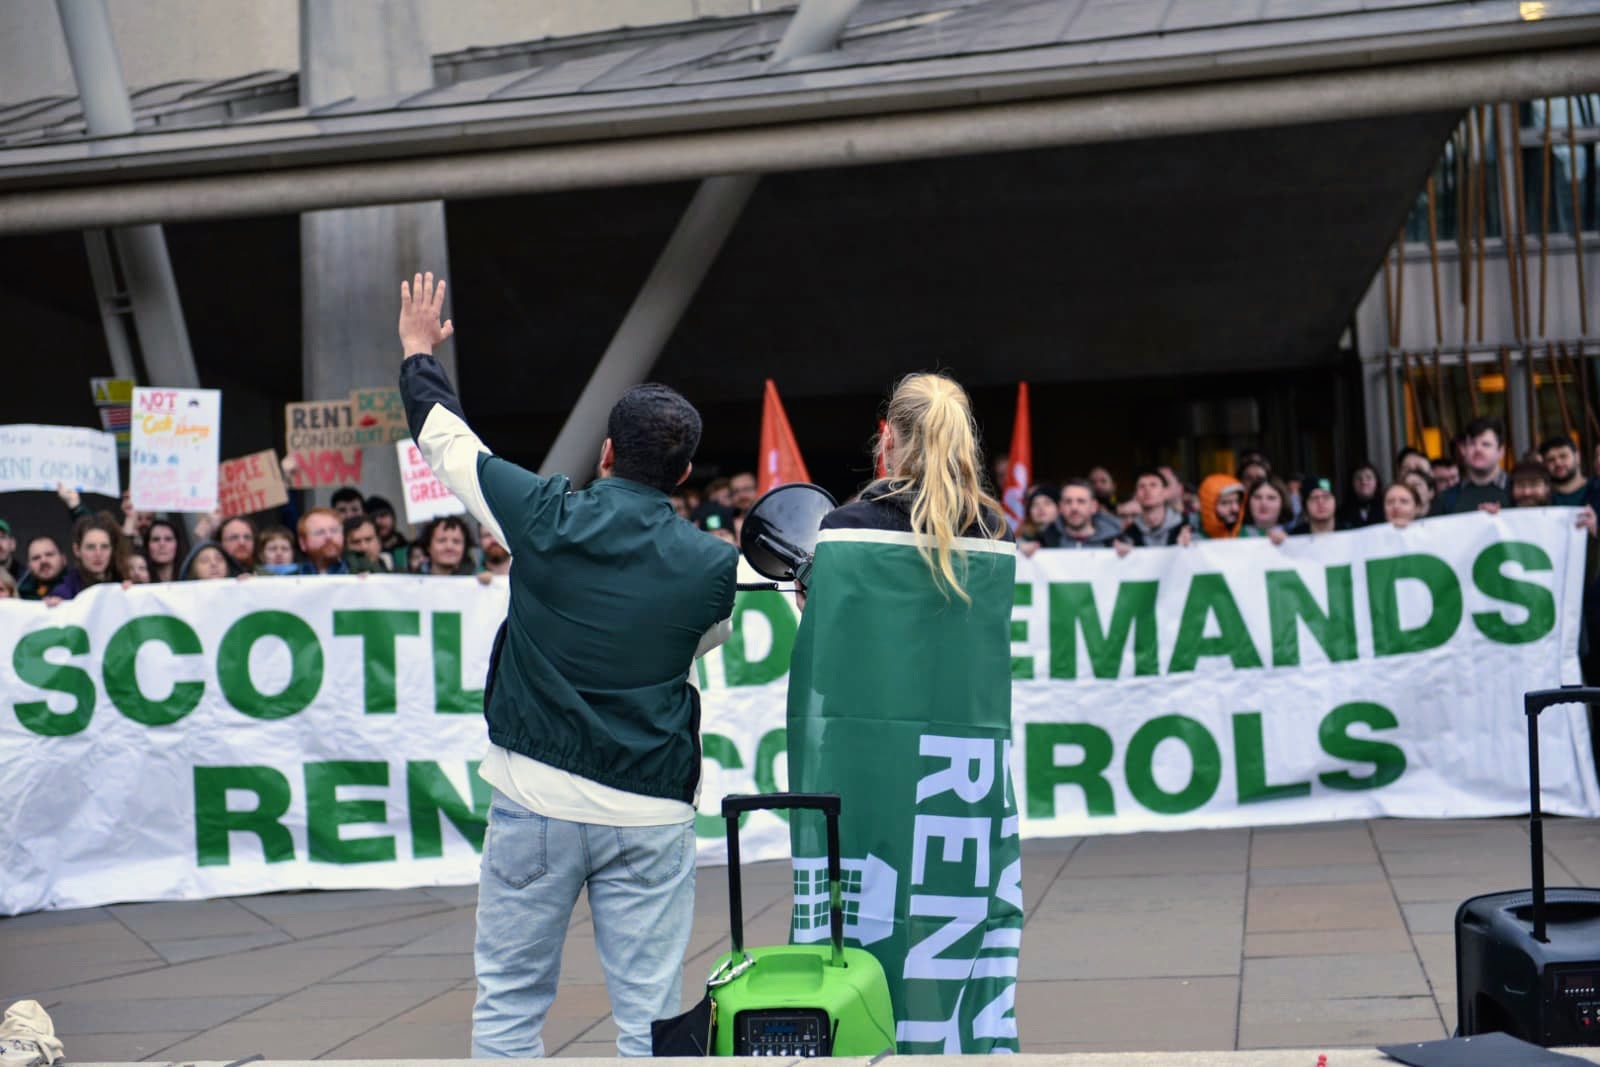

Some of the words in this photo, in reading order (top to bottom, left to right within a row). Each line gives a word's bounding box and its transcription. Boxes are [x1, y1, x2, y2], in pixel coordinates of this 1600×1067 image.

[140, 391, 177, 411] NOT
[294, 449, 362, 488] NOW
[12, 588, 799, 736] SCOTLD
[1011, 541, 1556, 680] MANDS
[193, 760, 490, 868] REN
